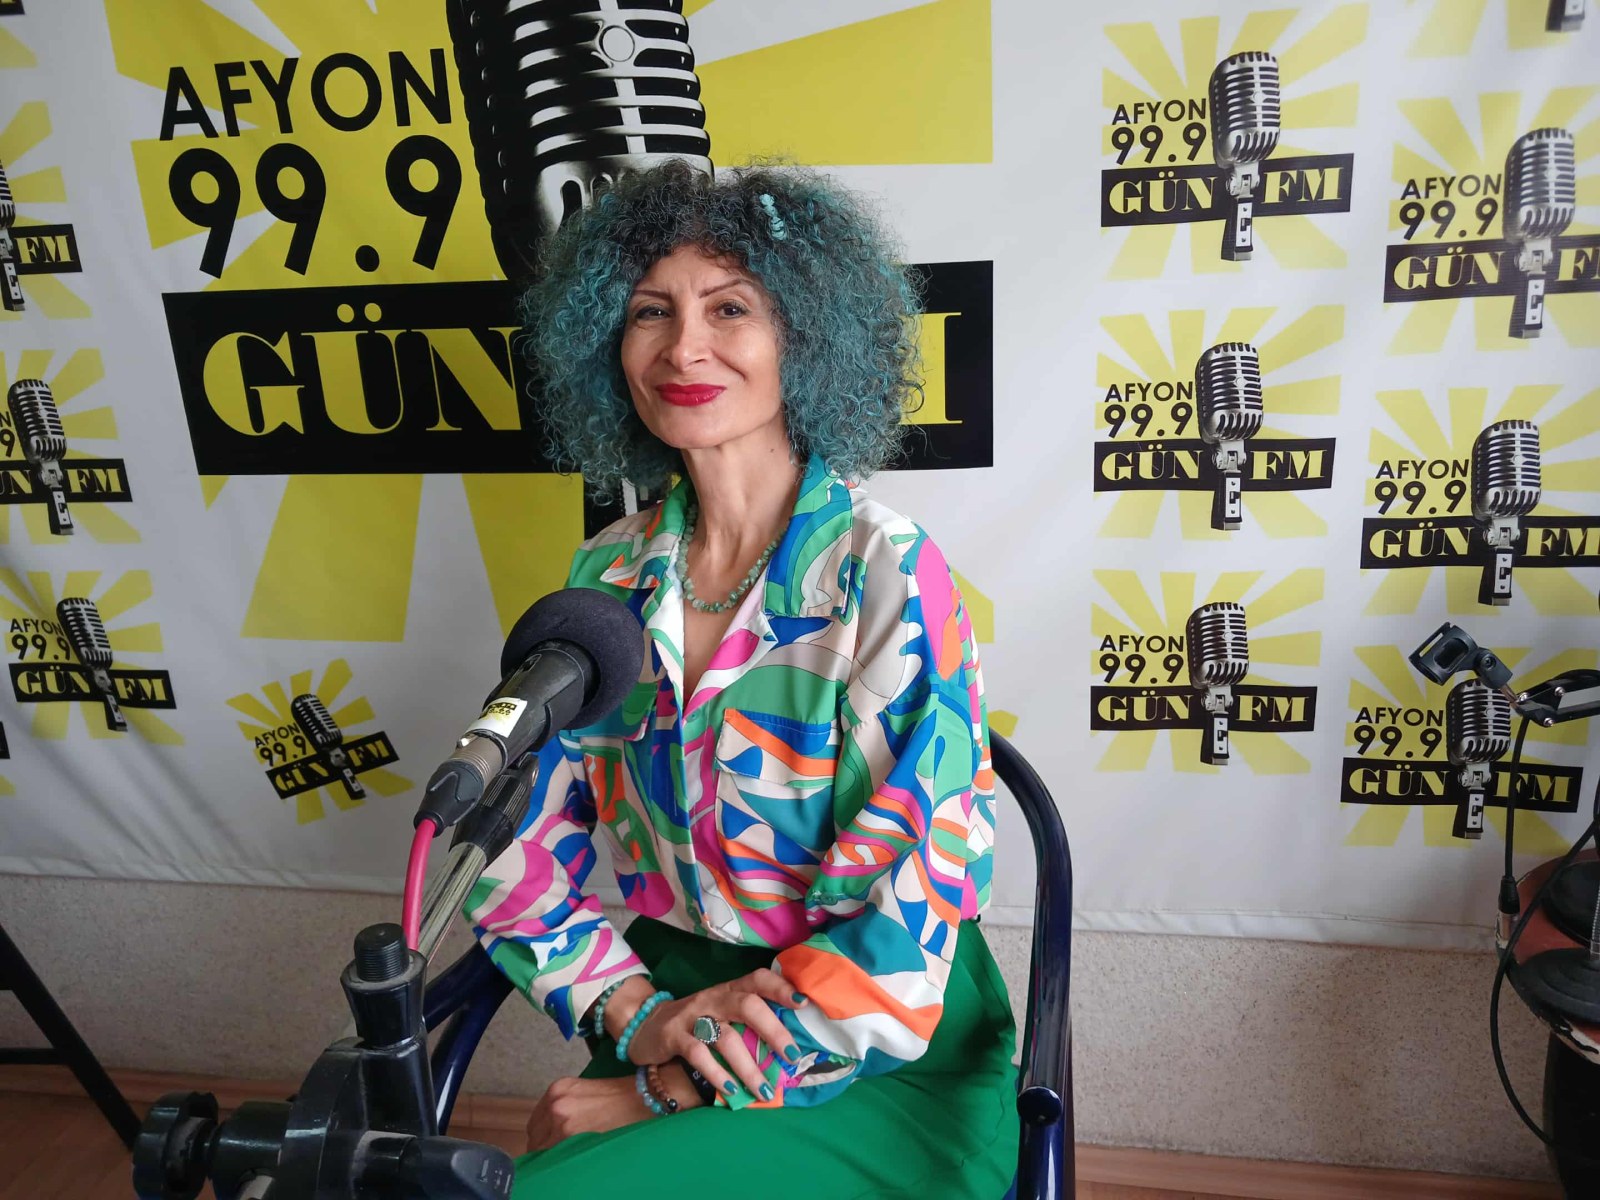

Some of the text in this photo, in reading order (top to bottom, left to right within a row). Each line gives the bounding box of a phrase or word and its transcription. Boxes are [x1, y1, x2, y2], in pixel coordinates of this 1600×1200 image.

[160, 48, 452, 141] AFYON
[1112, 98, 1206, 125] AFYON
[1111, 122, 1207, 165] 99.9
[1109, 167, 1344, 214] GÜN FM
[1400, 173, 1502, 201] AFYON
[168, 134, 462, 279] 99.9
[1399, 197, 1498, 241] 99.9
[14, 234, 74, 264] FM
[1394, 246, 1600, 290] GÜN F
[203, 303, 523, 437] GÜN
[1104, 381, 1193, 403] AFYON
[1104, 402, 1193, 438] 99.9
[1101, 443, 1327, 481] GÜN FM
[1375, 459, 1470, 480] AFYON
[65, 468, 125, 494] FM
[1374, 480, 1467, 516] 99.9
[1369, 521, 1600, 559] GÜN FM
[10, 618, 66, 638] AFYON
[1100, 635, 1184, 653] AFYON
[11, 633, 71, 662] 99.9
[17, 665, 169, 701] GÜN FM
[1099, 653, 1185, 685] 99.9
[1097, 689, 1310, 723] GÜN FM
[1355, 706, 1445, 727] AFYON
[254, 722, 301, 749] AFYON
[259, 735, 308, 768] 99.9
[1353, 724, 1443, 759] 99.9
[1349, 763, 1573, 803] GÜN FM
